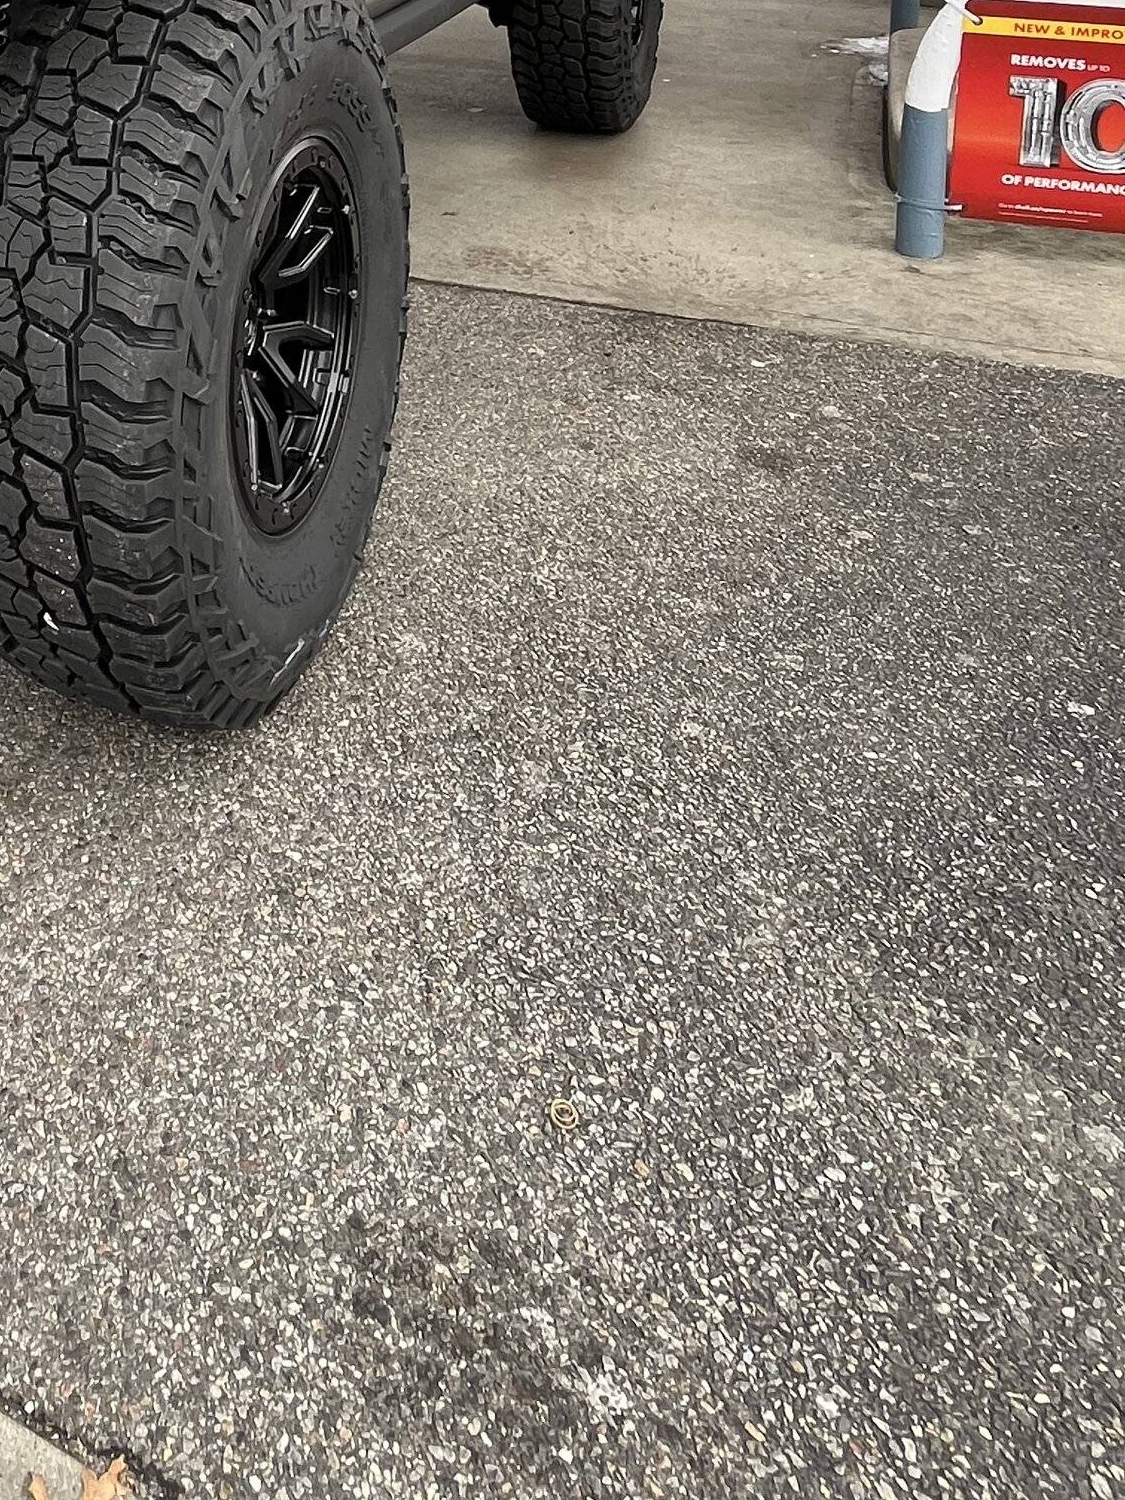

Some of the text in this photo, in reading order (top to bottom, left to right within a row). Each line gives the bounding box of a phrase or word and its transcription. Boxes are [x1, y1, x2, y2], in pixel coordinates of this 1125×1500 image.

[1015, 23, 1125, 40] NEW & IMPRO
[1010, 53, 1087, 71] REMOVES
[1001, 174, 1022, 186] OF
